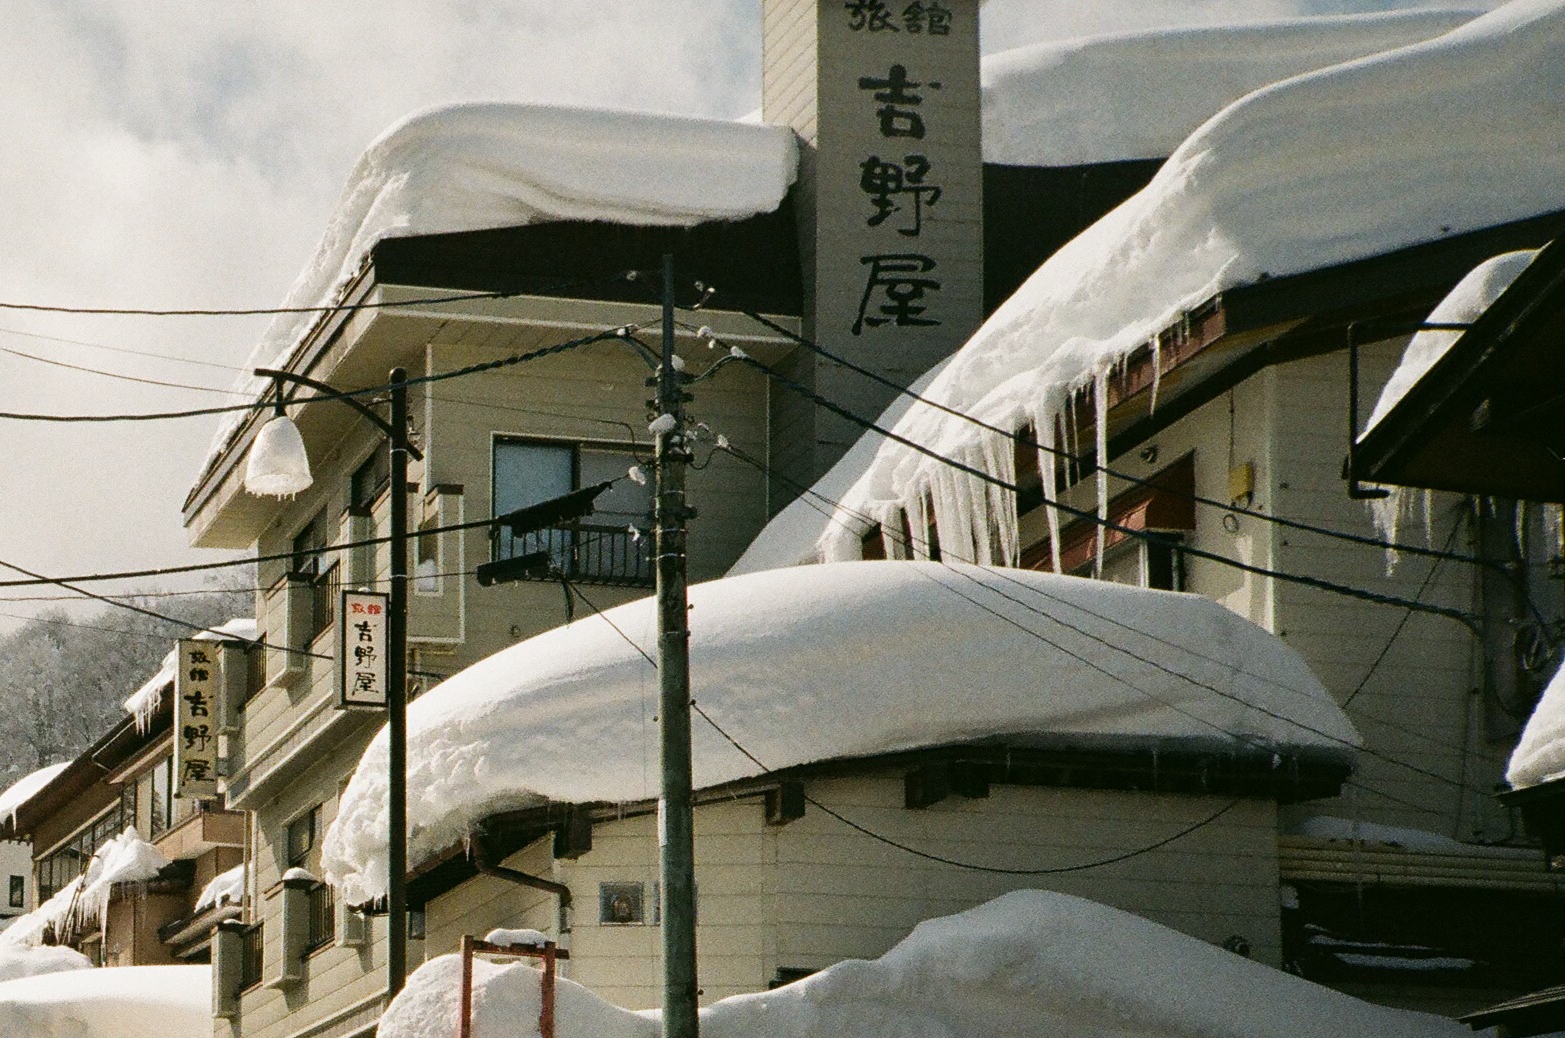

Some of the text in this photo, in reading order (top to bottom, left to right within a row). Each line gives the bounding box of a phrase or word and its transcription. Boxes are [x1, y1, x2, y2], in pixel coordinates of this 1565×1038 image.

[851, 64, 943, 336] 吉野屋
[352, 620, 379, 696] 吉野屋
[183, 691, 214, 786] 吉野屋
